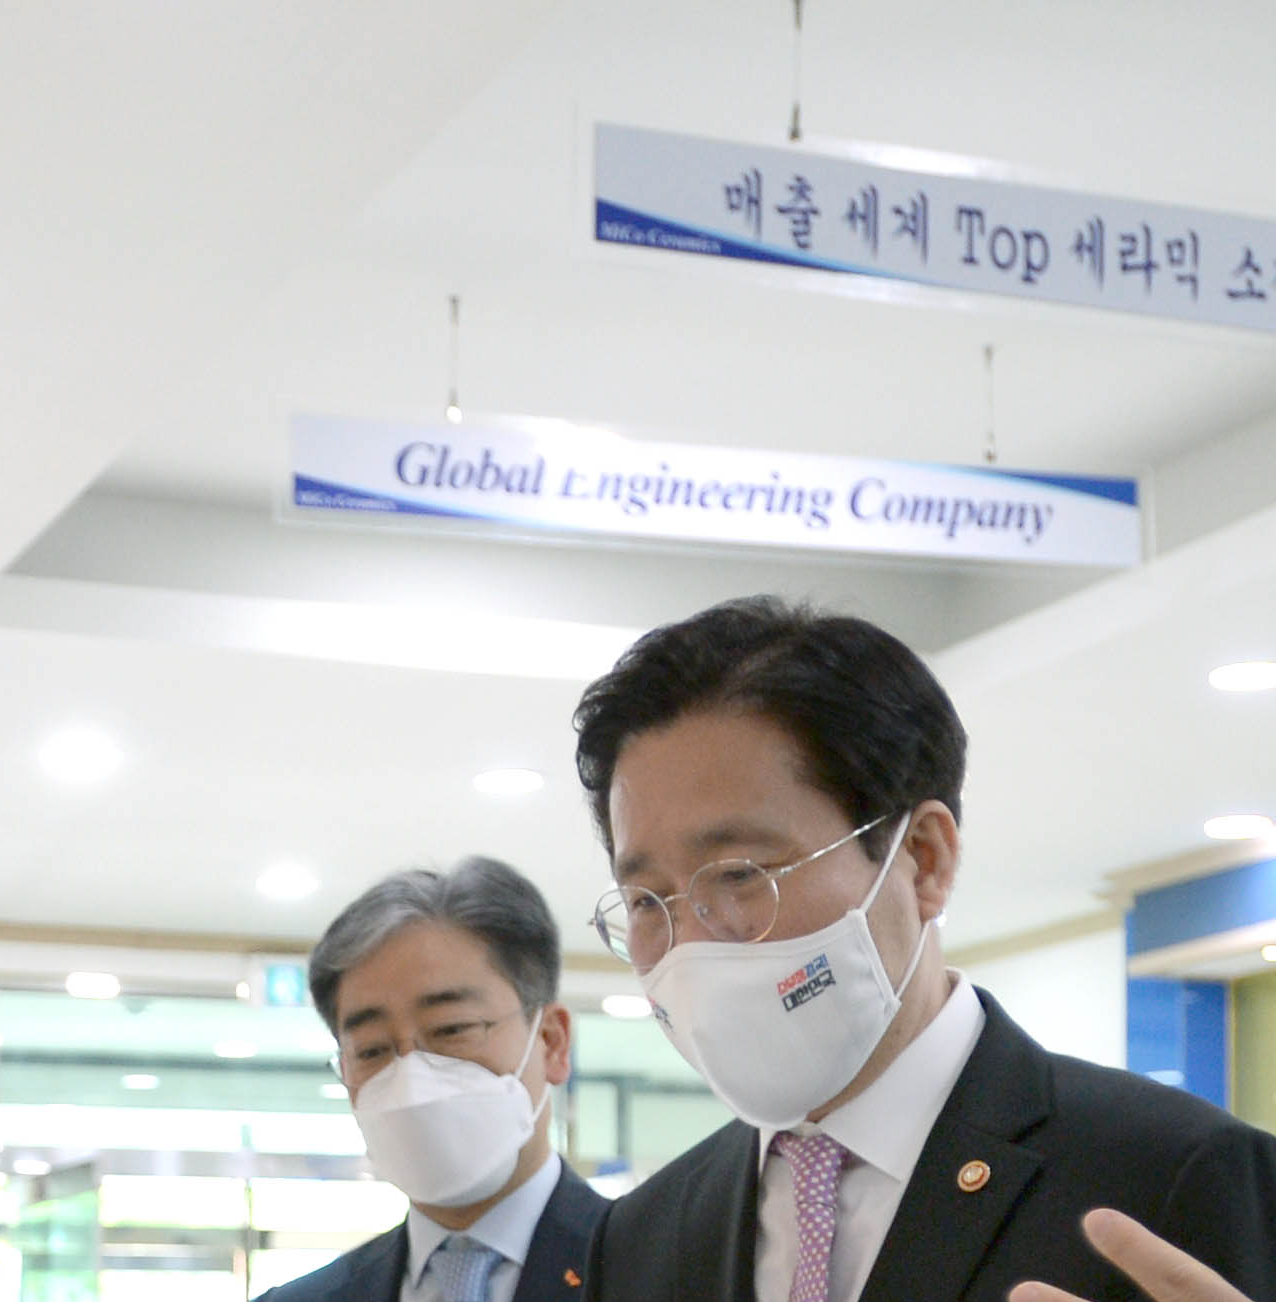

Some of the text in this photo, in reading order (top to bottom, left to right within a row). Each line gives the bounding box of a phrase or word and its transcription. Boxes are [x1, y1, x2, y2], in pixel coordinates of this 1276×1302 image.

[724, 167, 822, 251] 매출
[845, 184, 929, 267] 세계
[955, 204, 1051, 284] Top
[1071, 214, 1200, 303] 세라믹
[394, 440, 1054, 544] Global Engineering Company
